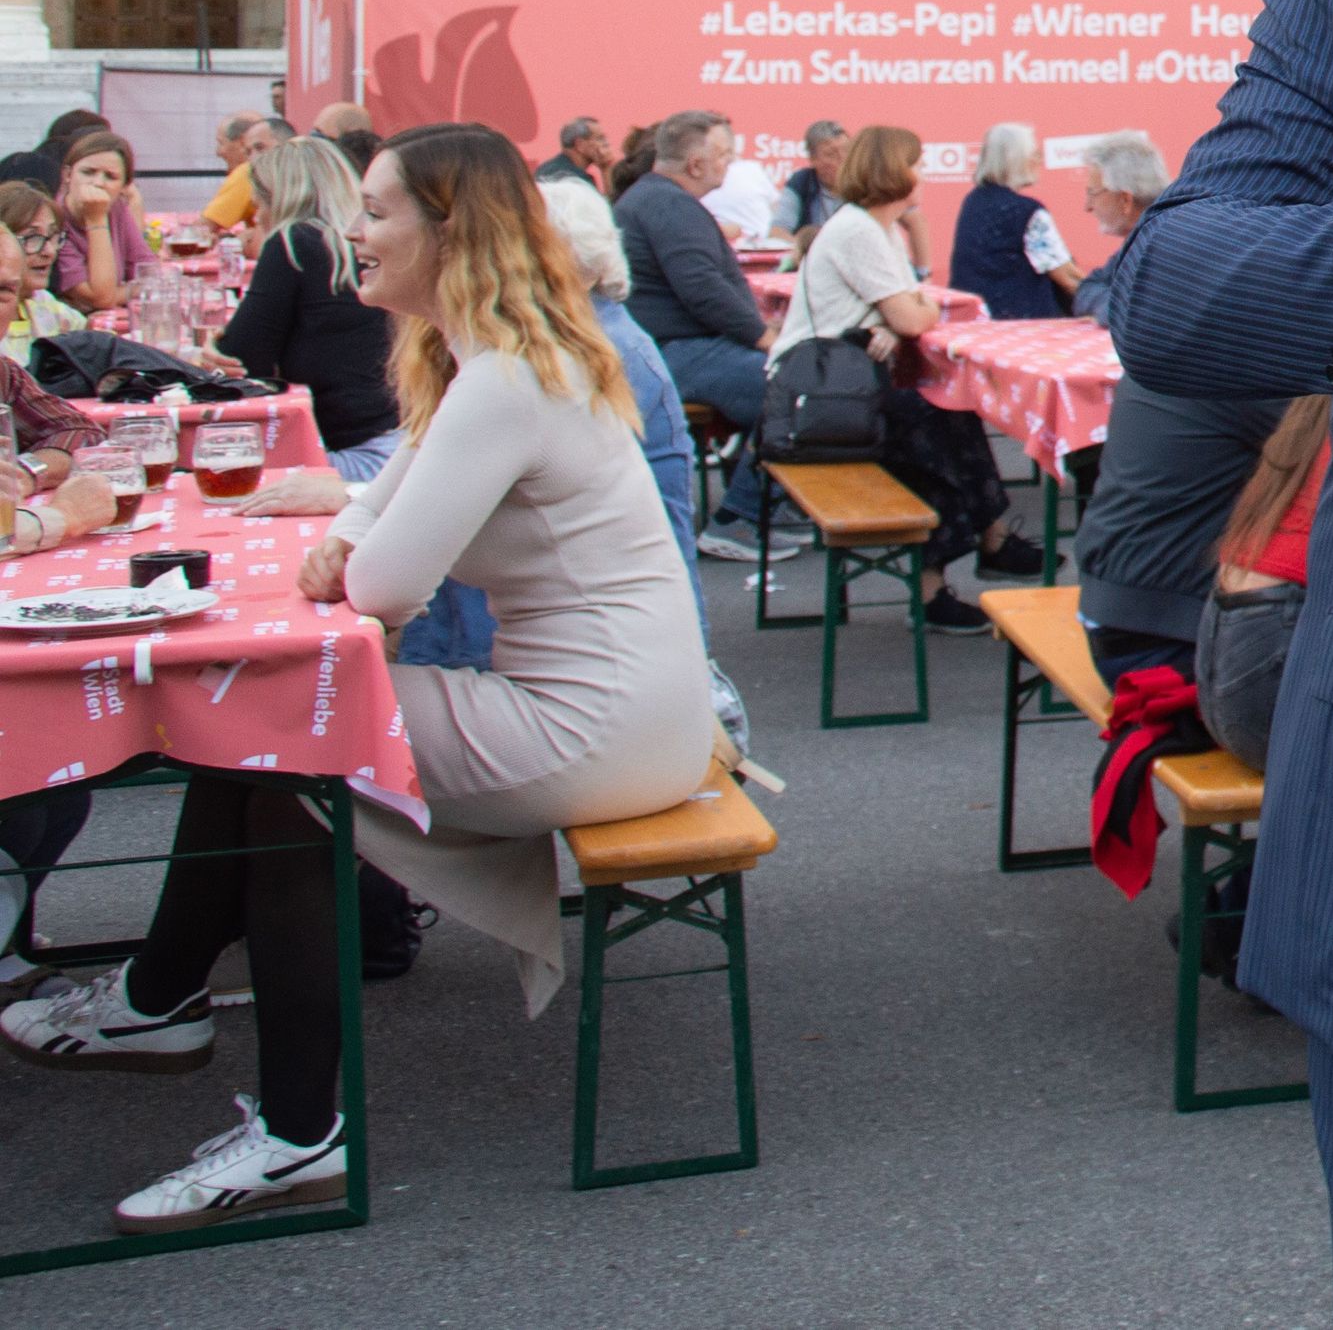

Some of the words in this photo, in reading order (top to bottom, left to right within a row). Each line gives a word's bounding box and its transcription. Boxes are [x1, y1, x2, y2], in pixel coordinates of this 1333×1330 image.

[700, 0, 996, 46] #Leberkas-Pepi
[1011, 4, 1166, 38] #Wiener
[700, 49, 803, 85] #Zum
[810, 49, 995, 85] Schwarzen
[1002, 50, 1128, 84] Kameel
[83, 672, 103, 721] Wien
